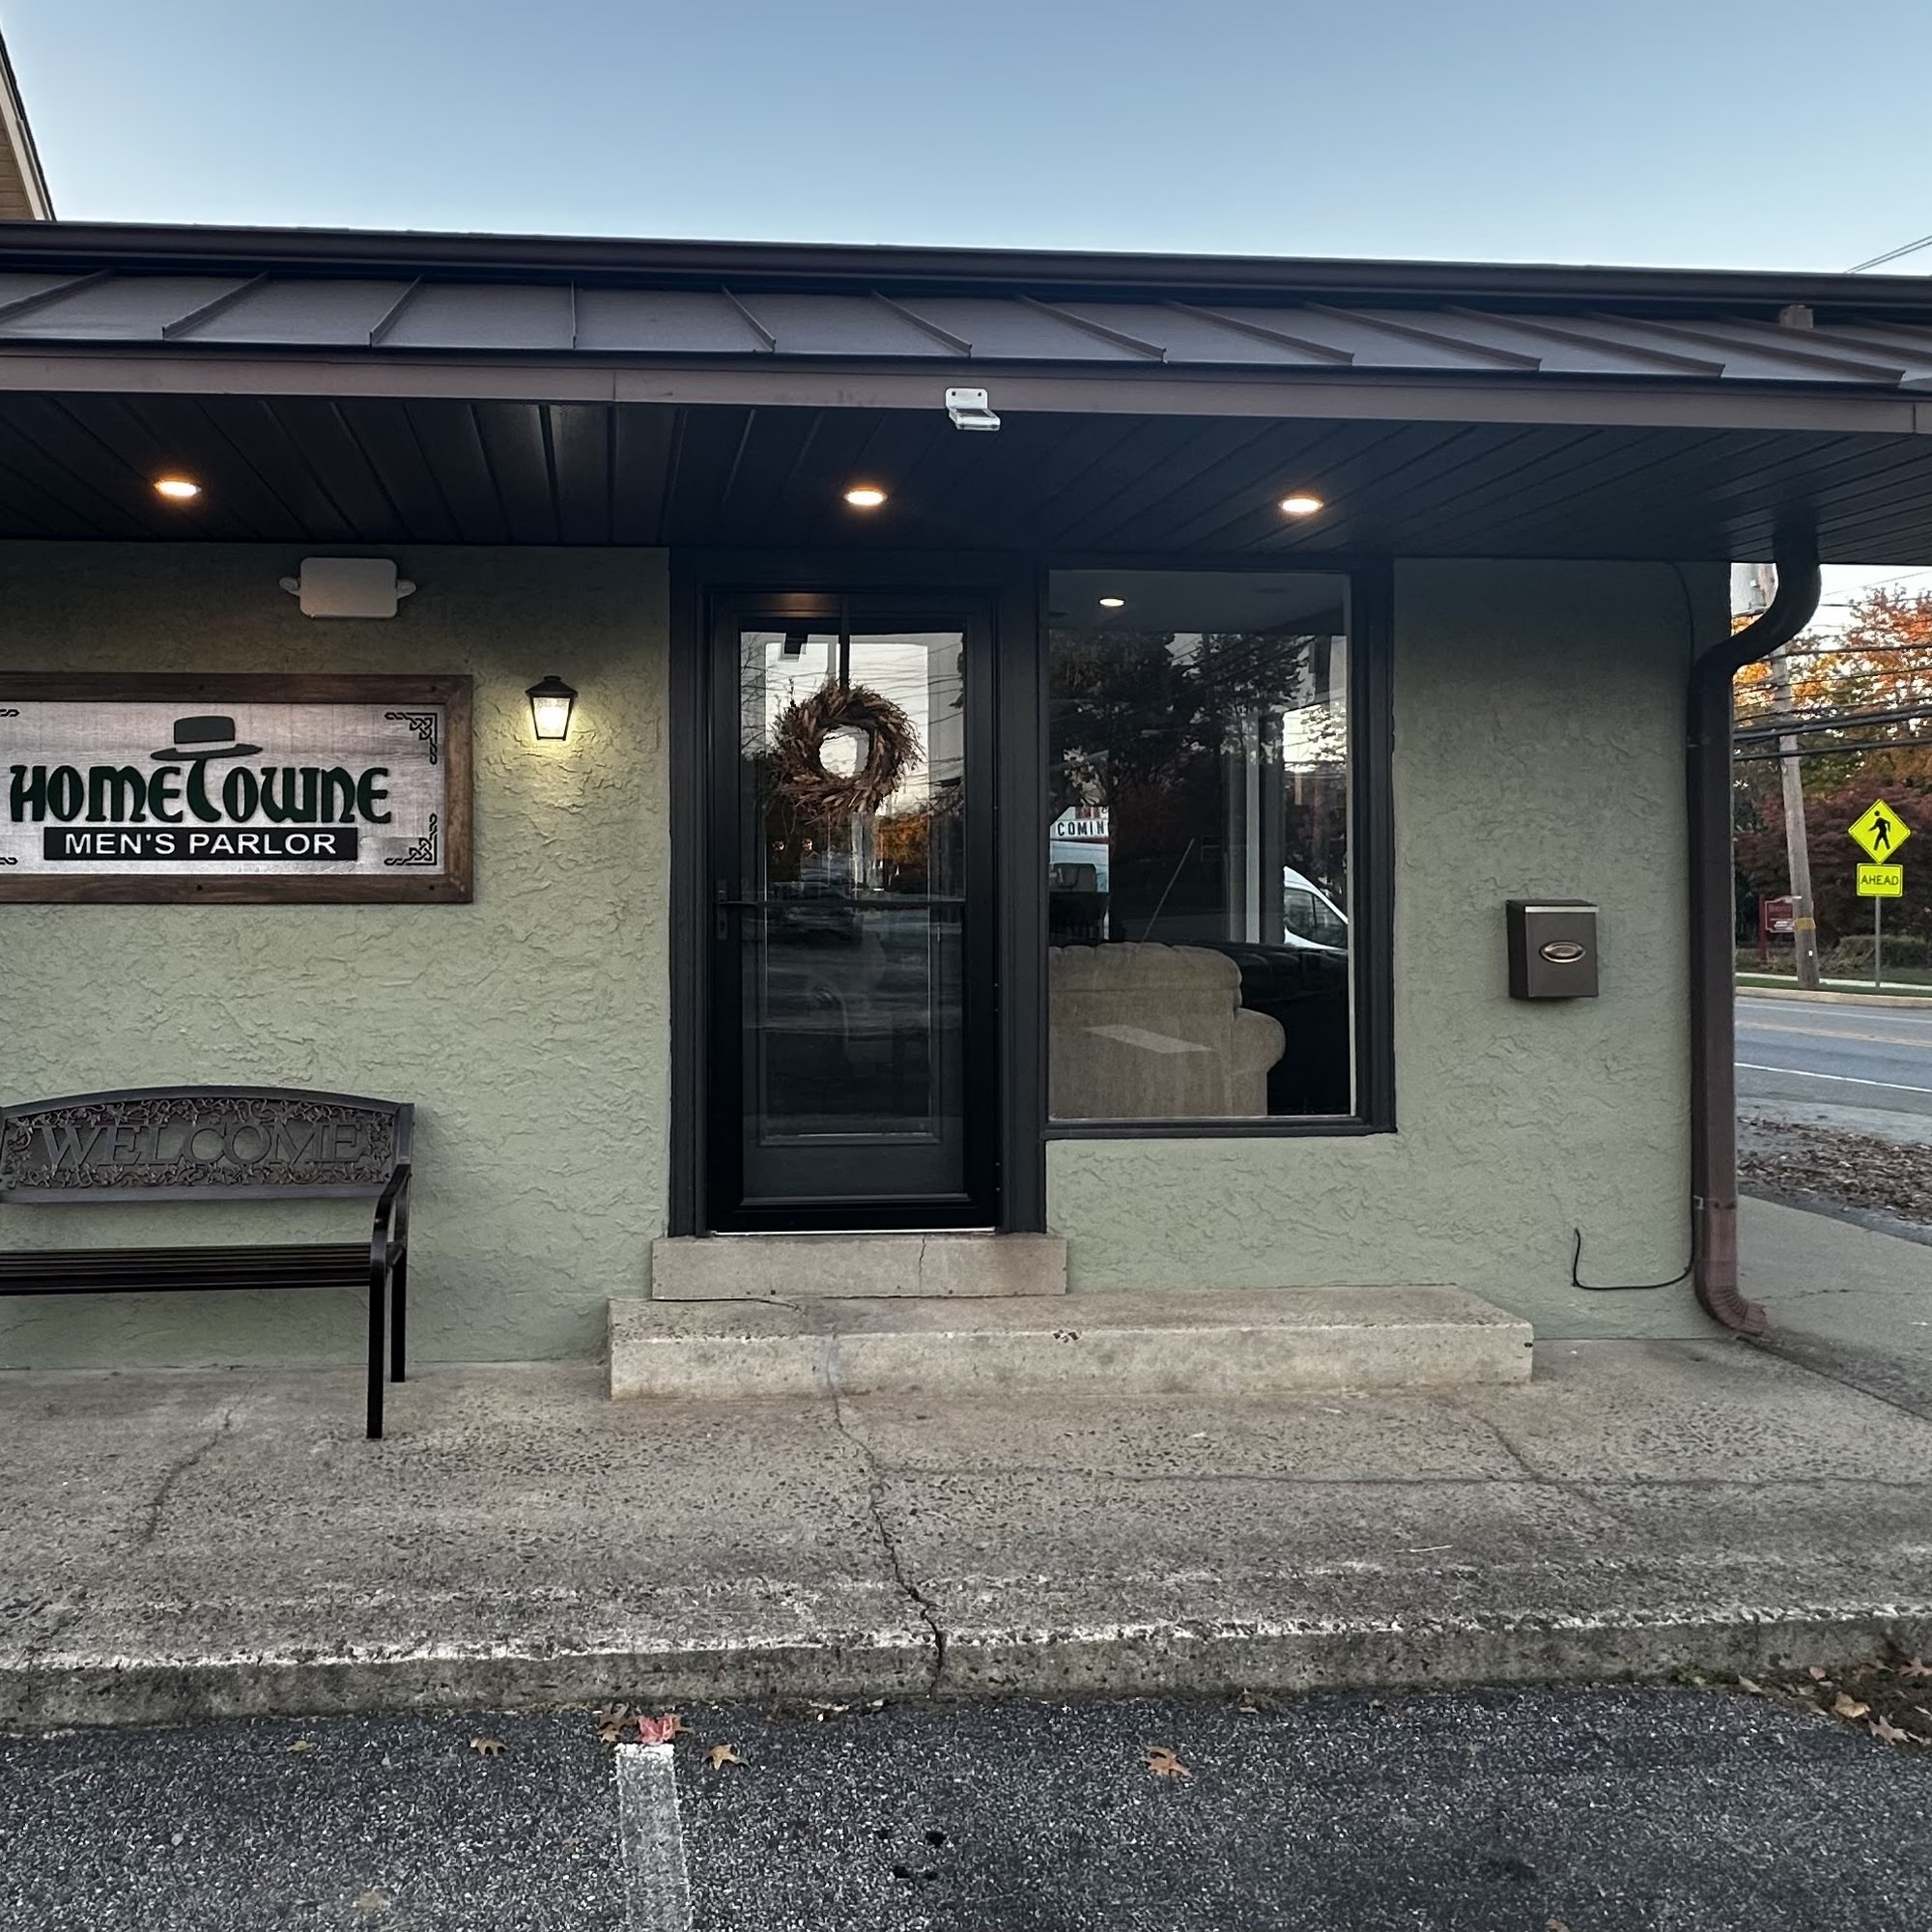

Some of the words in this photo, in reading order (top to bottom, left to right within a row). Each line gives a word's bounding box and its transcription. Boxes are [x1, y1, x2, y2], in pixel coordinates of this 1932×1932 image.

[65, 834, 176, 855] MEN'S
[189, 834, 337, 855] PARLOR
[1861, 874, 1899, 886] AHEAD
[35, 1122, 365, 1171] WELCOME
